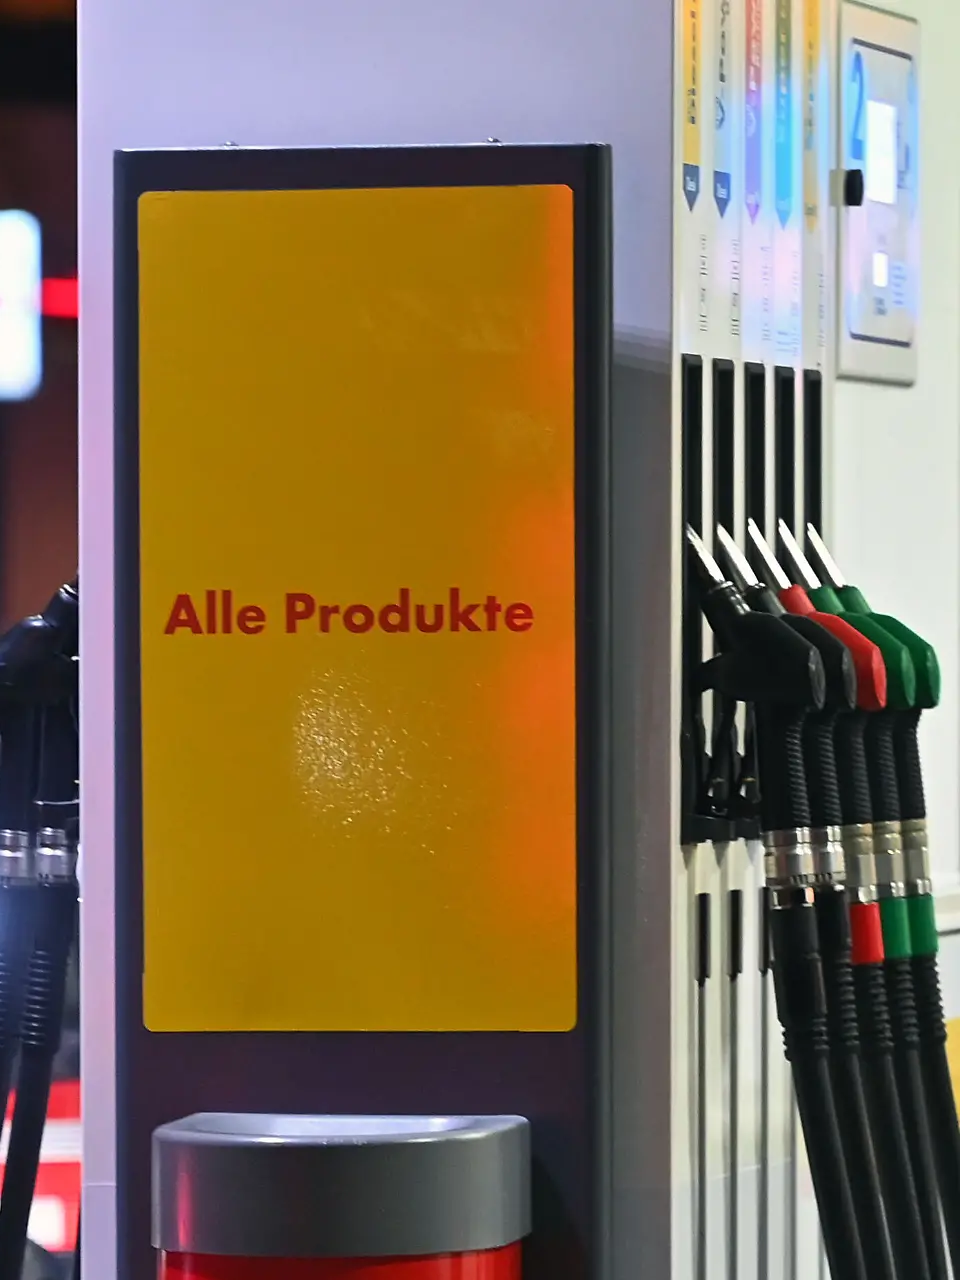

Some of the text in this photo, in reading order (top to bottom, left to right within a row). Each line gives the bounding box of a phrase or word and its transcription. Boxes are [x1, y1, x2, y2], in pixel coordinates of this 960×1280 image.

[851, 51, 865, 160] 2
[163, 587, 534, 635] Alle Produkte
